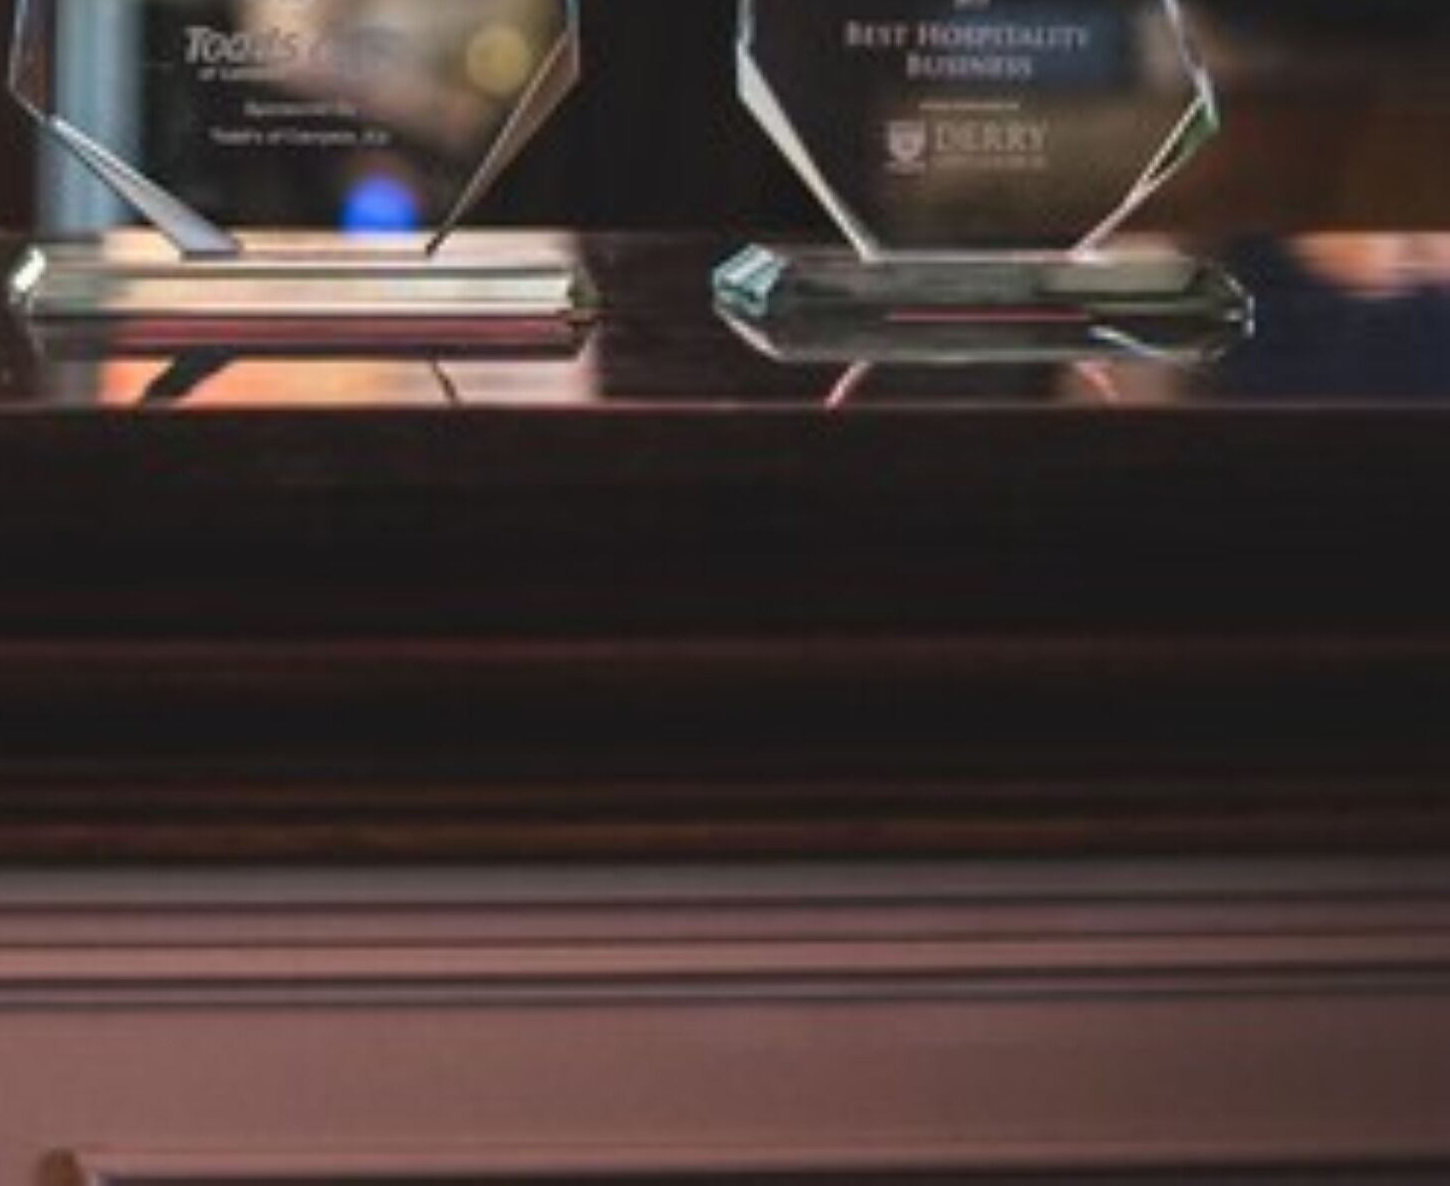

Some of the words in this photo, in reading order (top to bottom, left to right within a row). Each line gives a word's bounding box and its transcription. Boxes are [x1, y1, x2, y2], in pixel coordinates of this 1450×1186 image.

[845, 20, 910, 47] BEST
[916, 20, 1089, 49] HOSPITALITY
[905, 54, 1034, 80] BUSINESS
[935, 120, 1048, 153] DERRY
